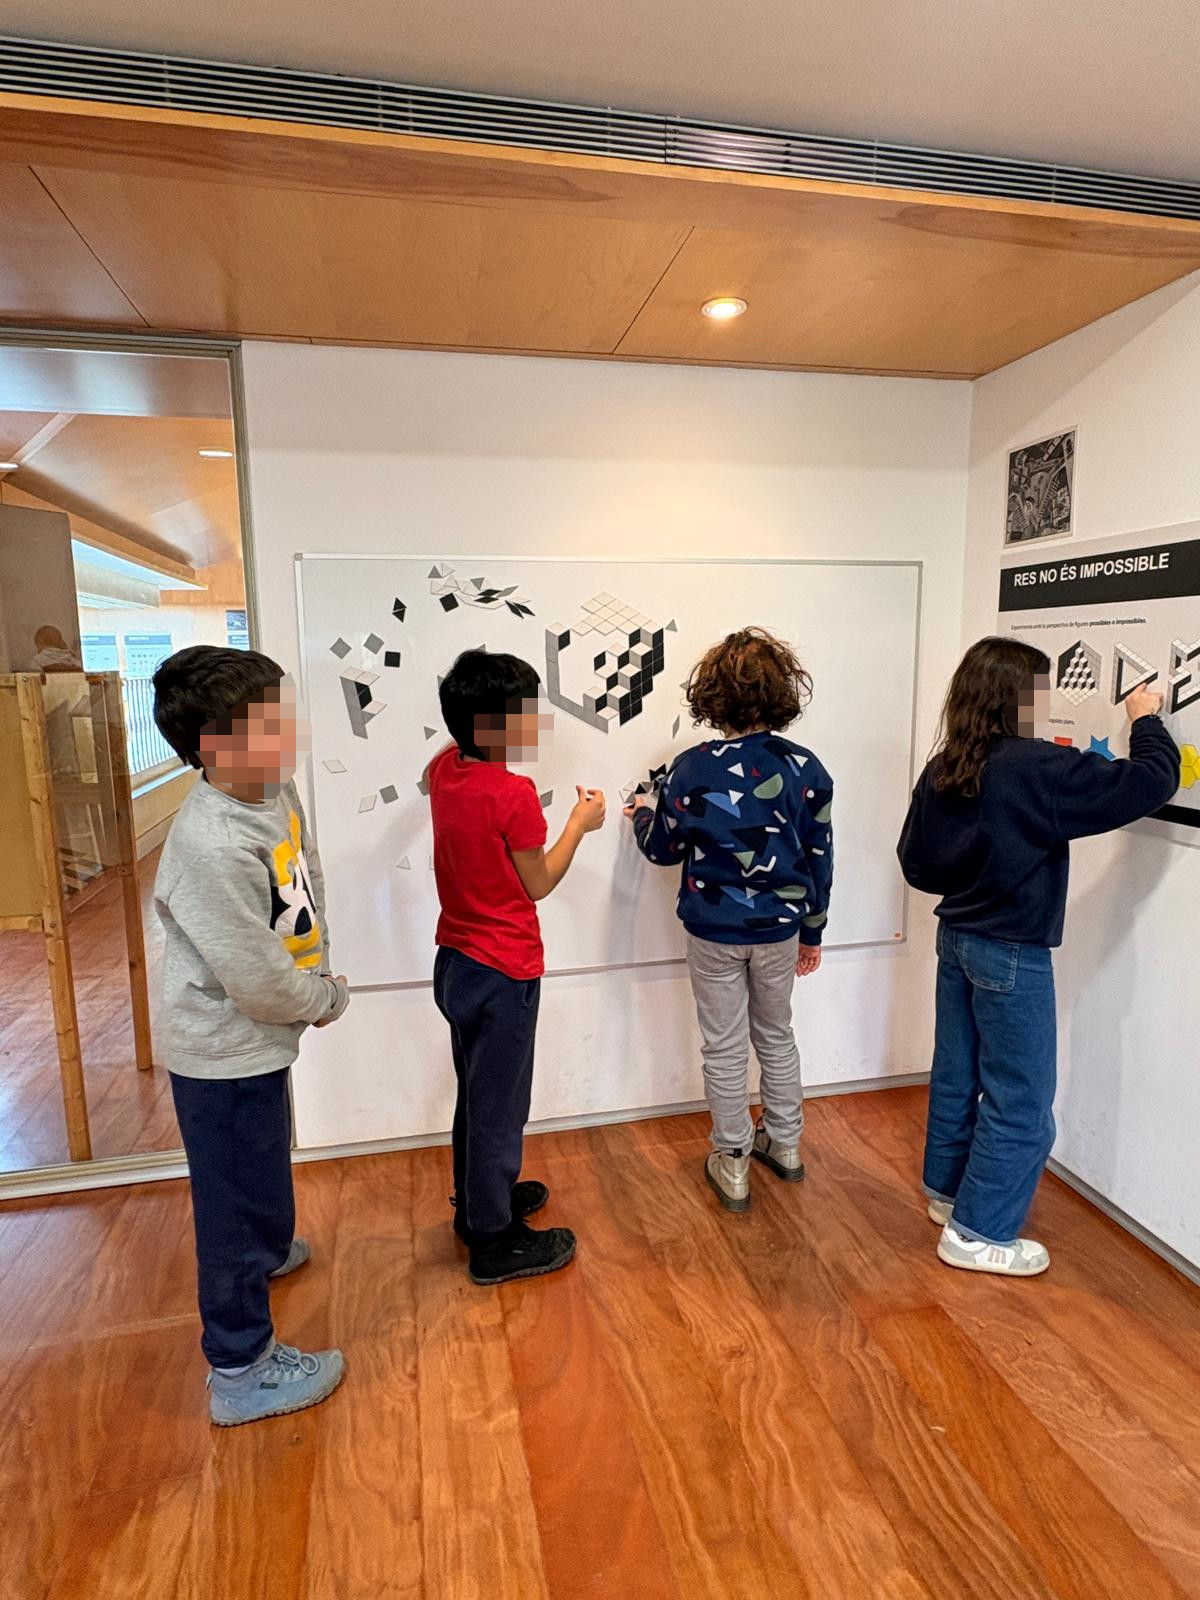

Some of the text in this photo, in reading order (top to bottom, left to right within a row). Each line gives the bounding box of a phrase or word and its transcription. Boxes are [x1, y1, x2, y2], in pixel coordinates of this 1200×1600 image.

[1014, 552, 1170, 587] RES NO ÉS IMPOSSIBLE
